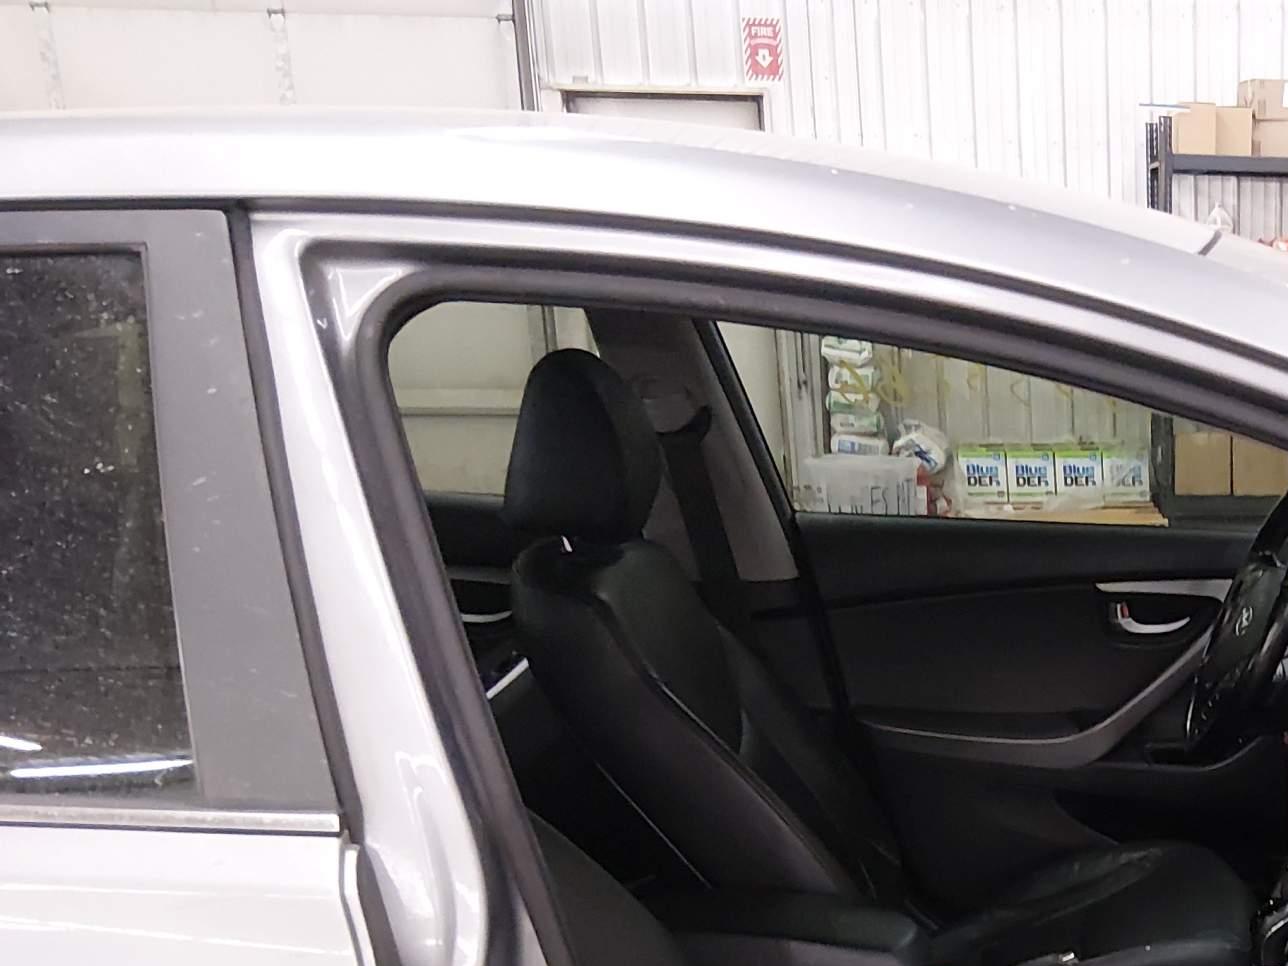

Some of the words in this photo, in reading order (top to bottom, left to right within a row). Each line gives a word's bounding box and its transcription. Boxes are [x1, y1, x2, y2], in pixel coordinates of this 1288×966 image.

[751, 26, 774, 37] FIRE
[966, 463, 999, 476] Blue
[1015, 464, 1048, 476] Blue
[1062, 463, 1095, 476] Blue
